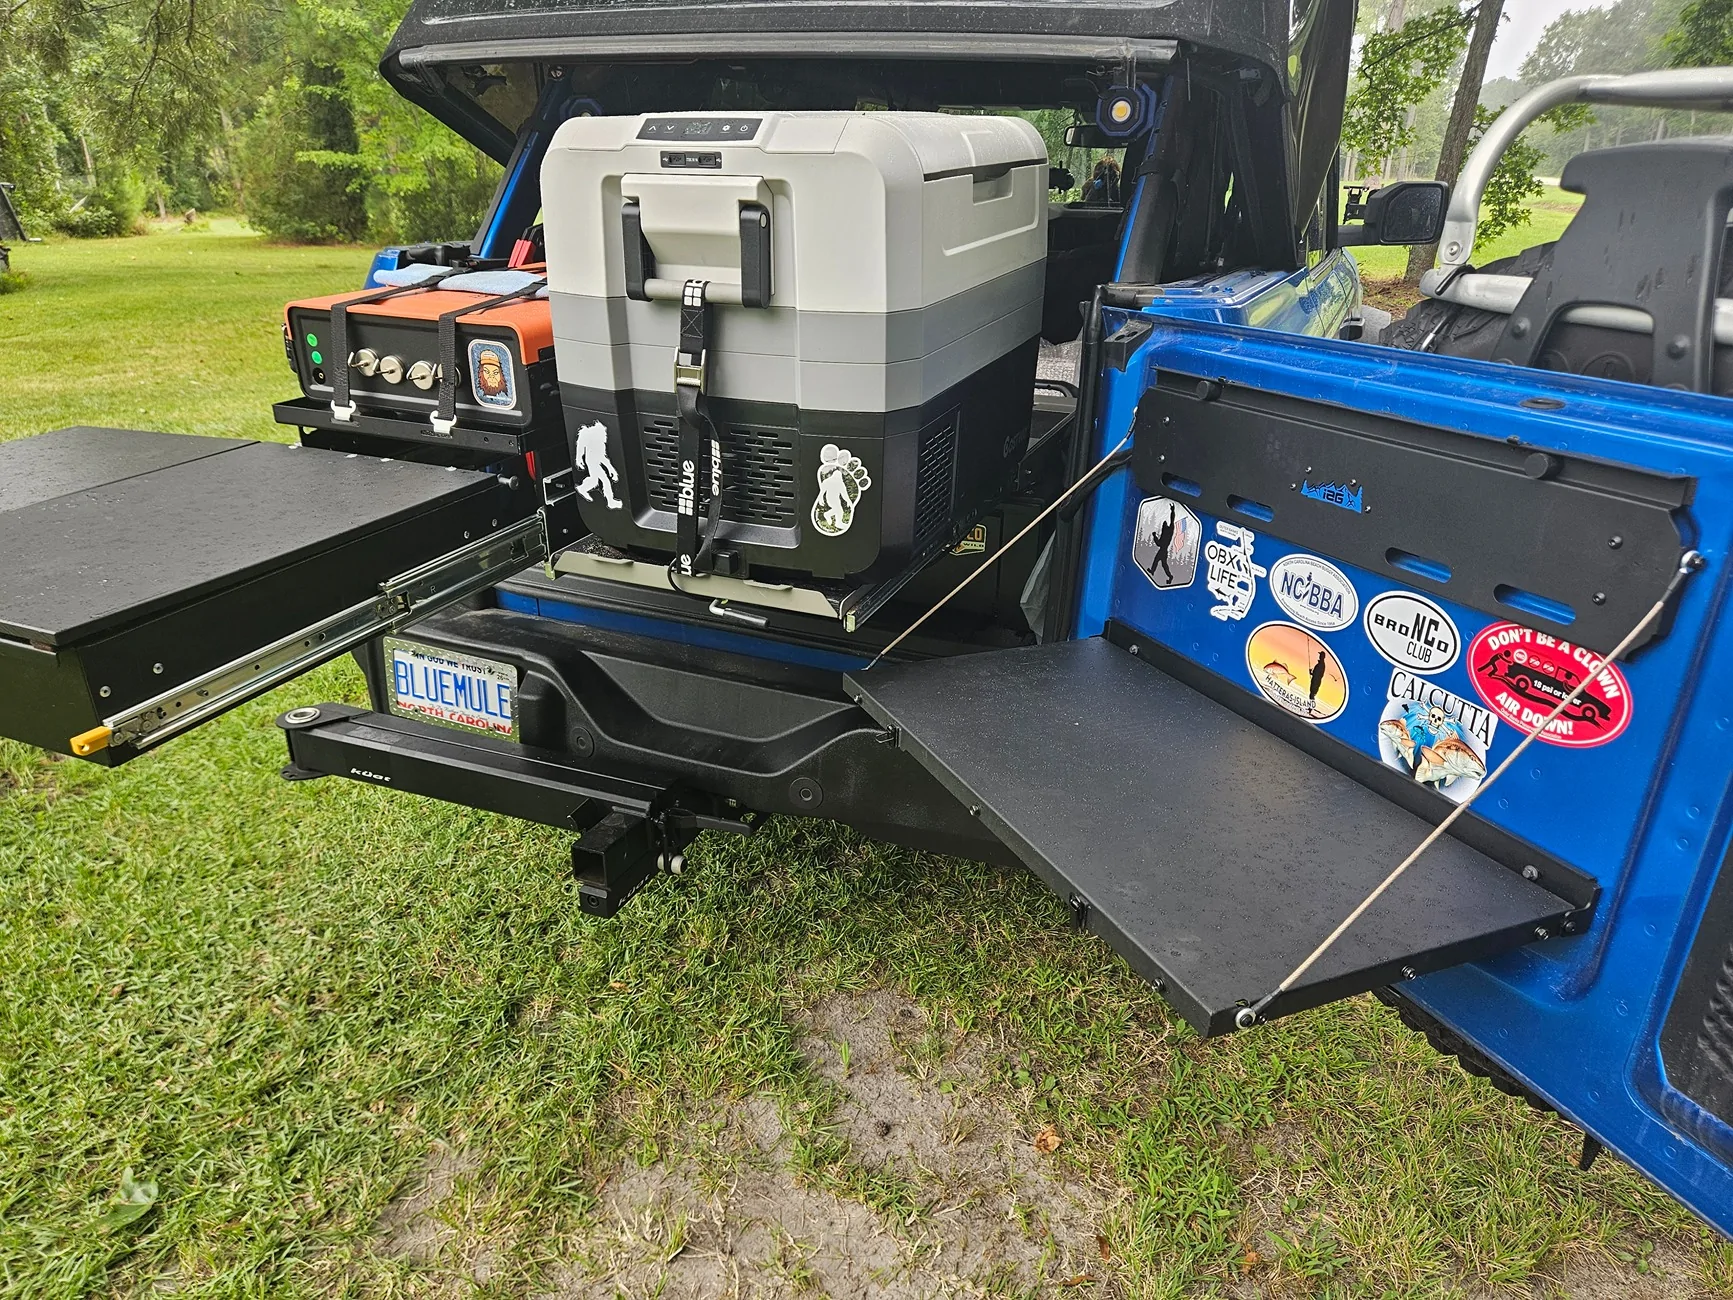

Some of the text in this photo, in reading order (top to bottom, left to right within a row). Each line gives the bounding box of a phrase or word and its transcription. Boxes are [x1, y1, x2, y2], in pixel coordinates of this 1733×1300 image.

[678, 459, 695, 497] blue
[711, 458, 722, 497] blue
[1208, 544, 1238, 570] OBX
[1210, 564, 1238, 589] LIFE
[1374, 612, 1450, 654] BRONCO
[1406, 641, 1432, 664] CLUB
[1487, 628, 1621, 700] DON'T BE A CLOWN
[394, 659, 511, 720] BLUEMULE
[1391, 671, 1491, 747] CALCUTTA
[1541, 685, 1554, 694] psi
[1561, 691, 1582, 706] loer
[1495, 691, 1574, 735] AIR DOWN!
